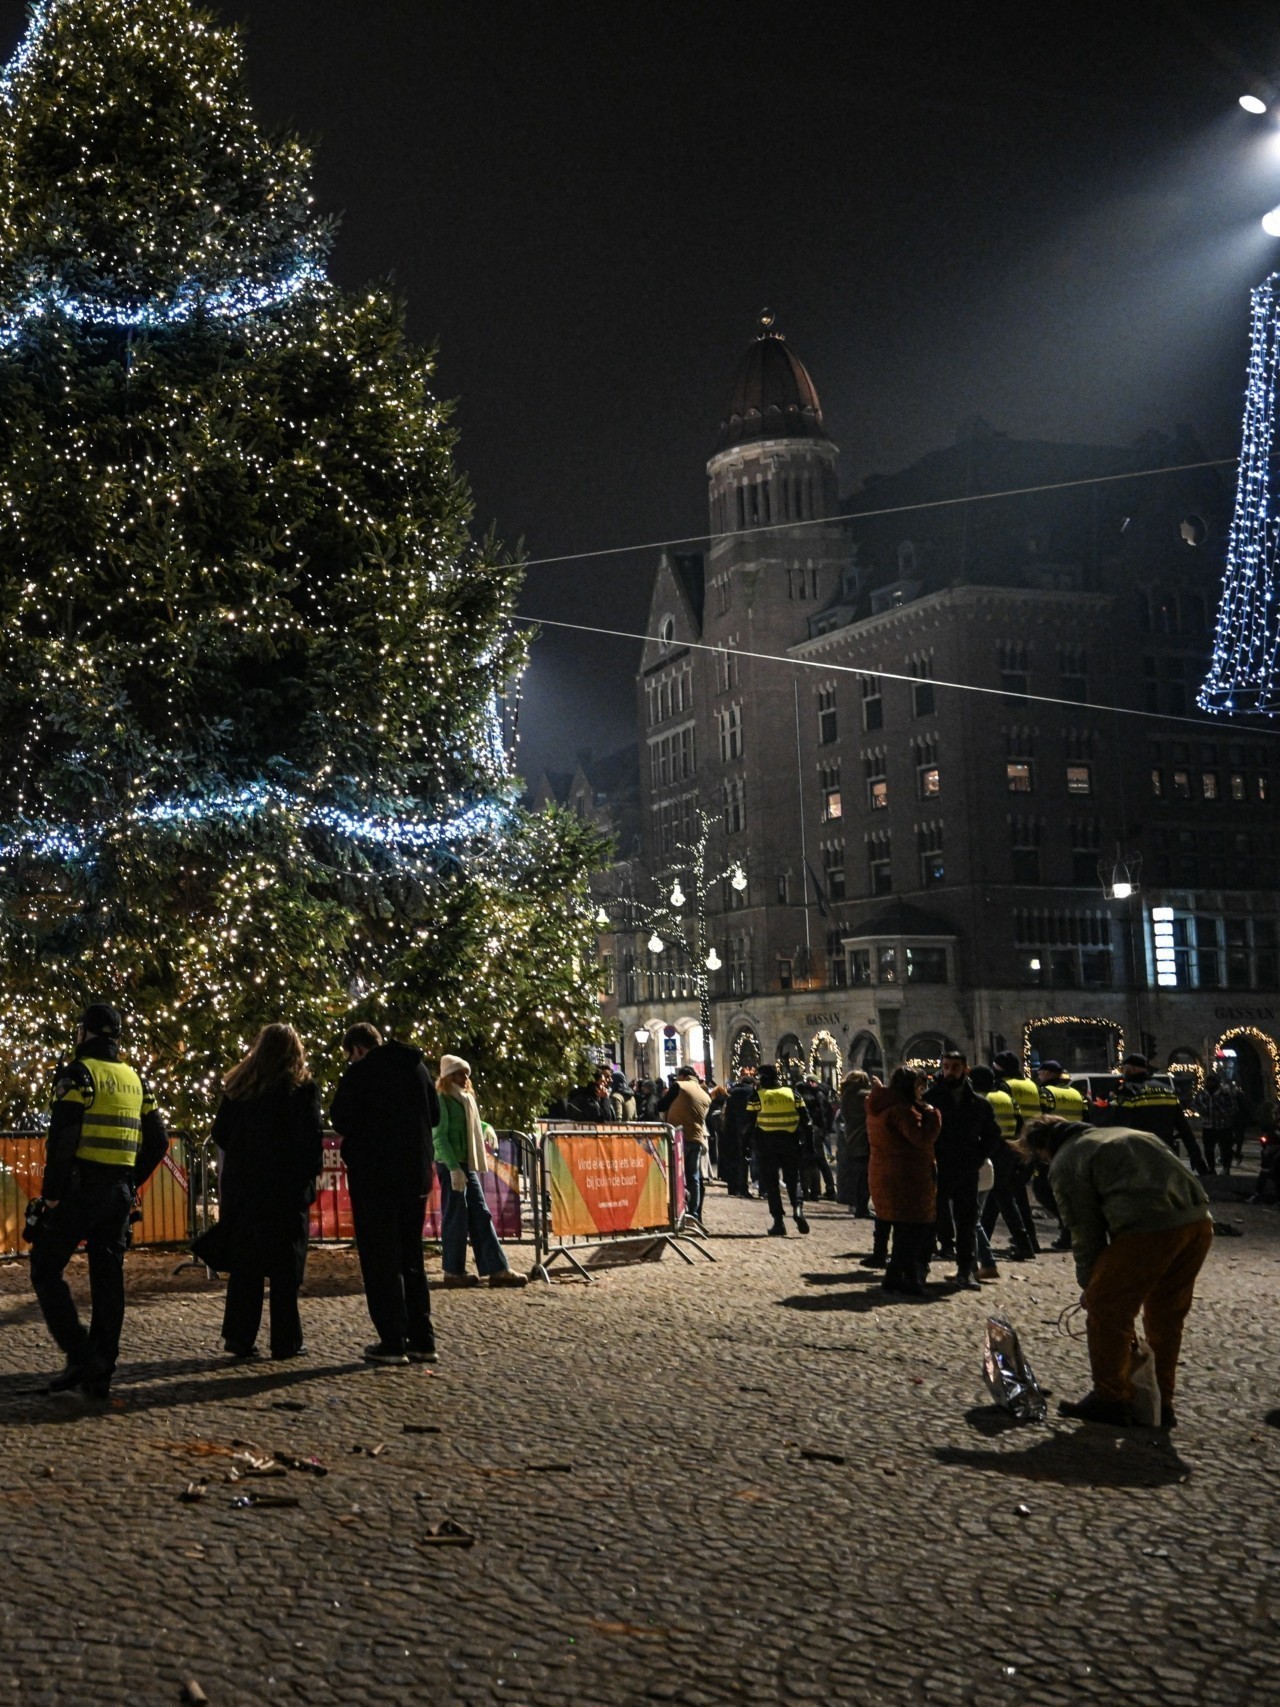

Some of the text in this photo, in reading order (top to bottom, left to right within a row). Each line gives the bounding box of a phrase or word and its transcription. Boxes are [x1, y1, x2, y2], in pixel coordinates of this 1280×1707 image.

[806, 1011, 841, 1026] GASSAN
[1214, 1006, 1275, 1020] GASSAN
[99, 1077, 141, 1096] POLITIE
[577, 1158, 592, 1171] Vind
[629, 1156, 644, 1169] leuks
